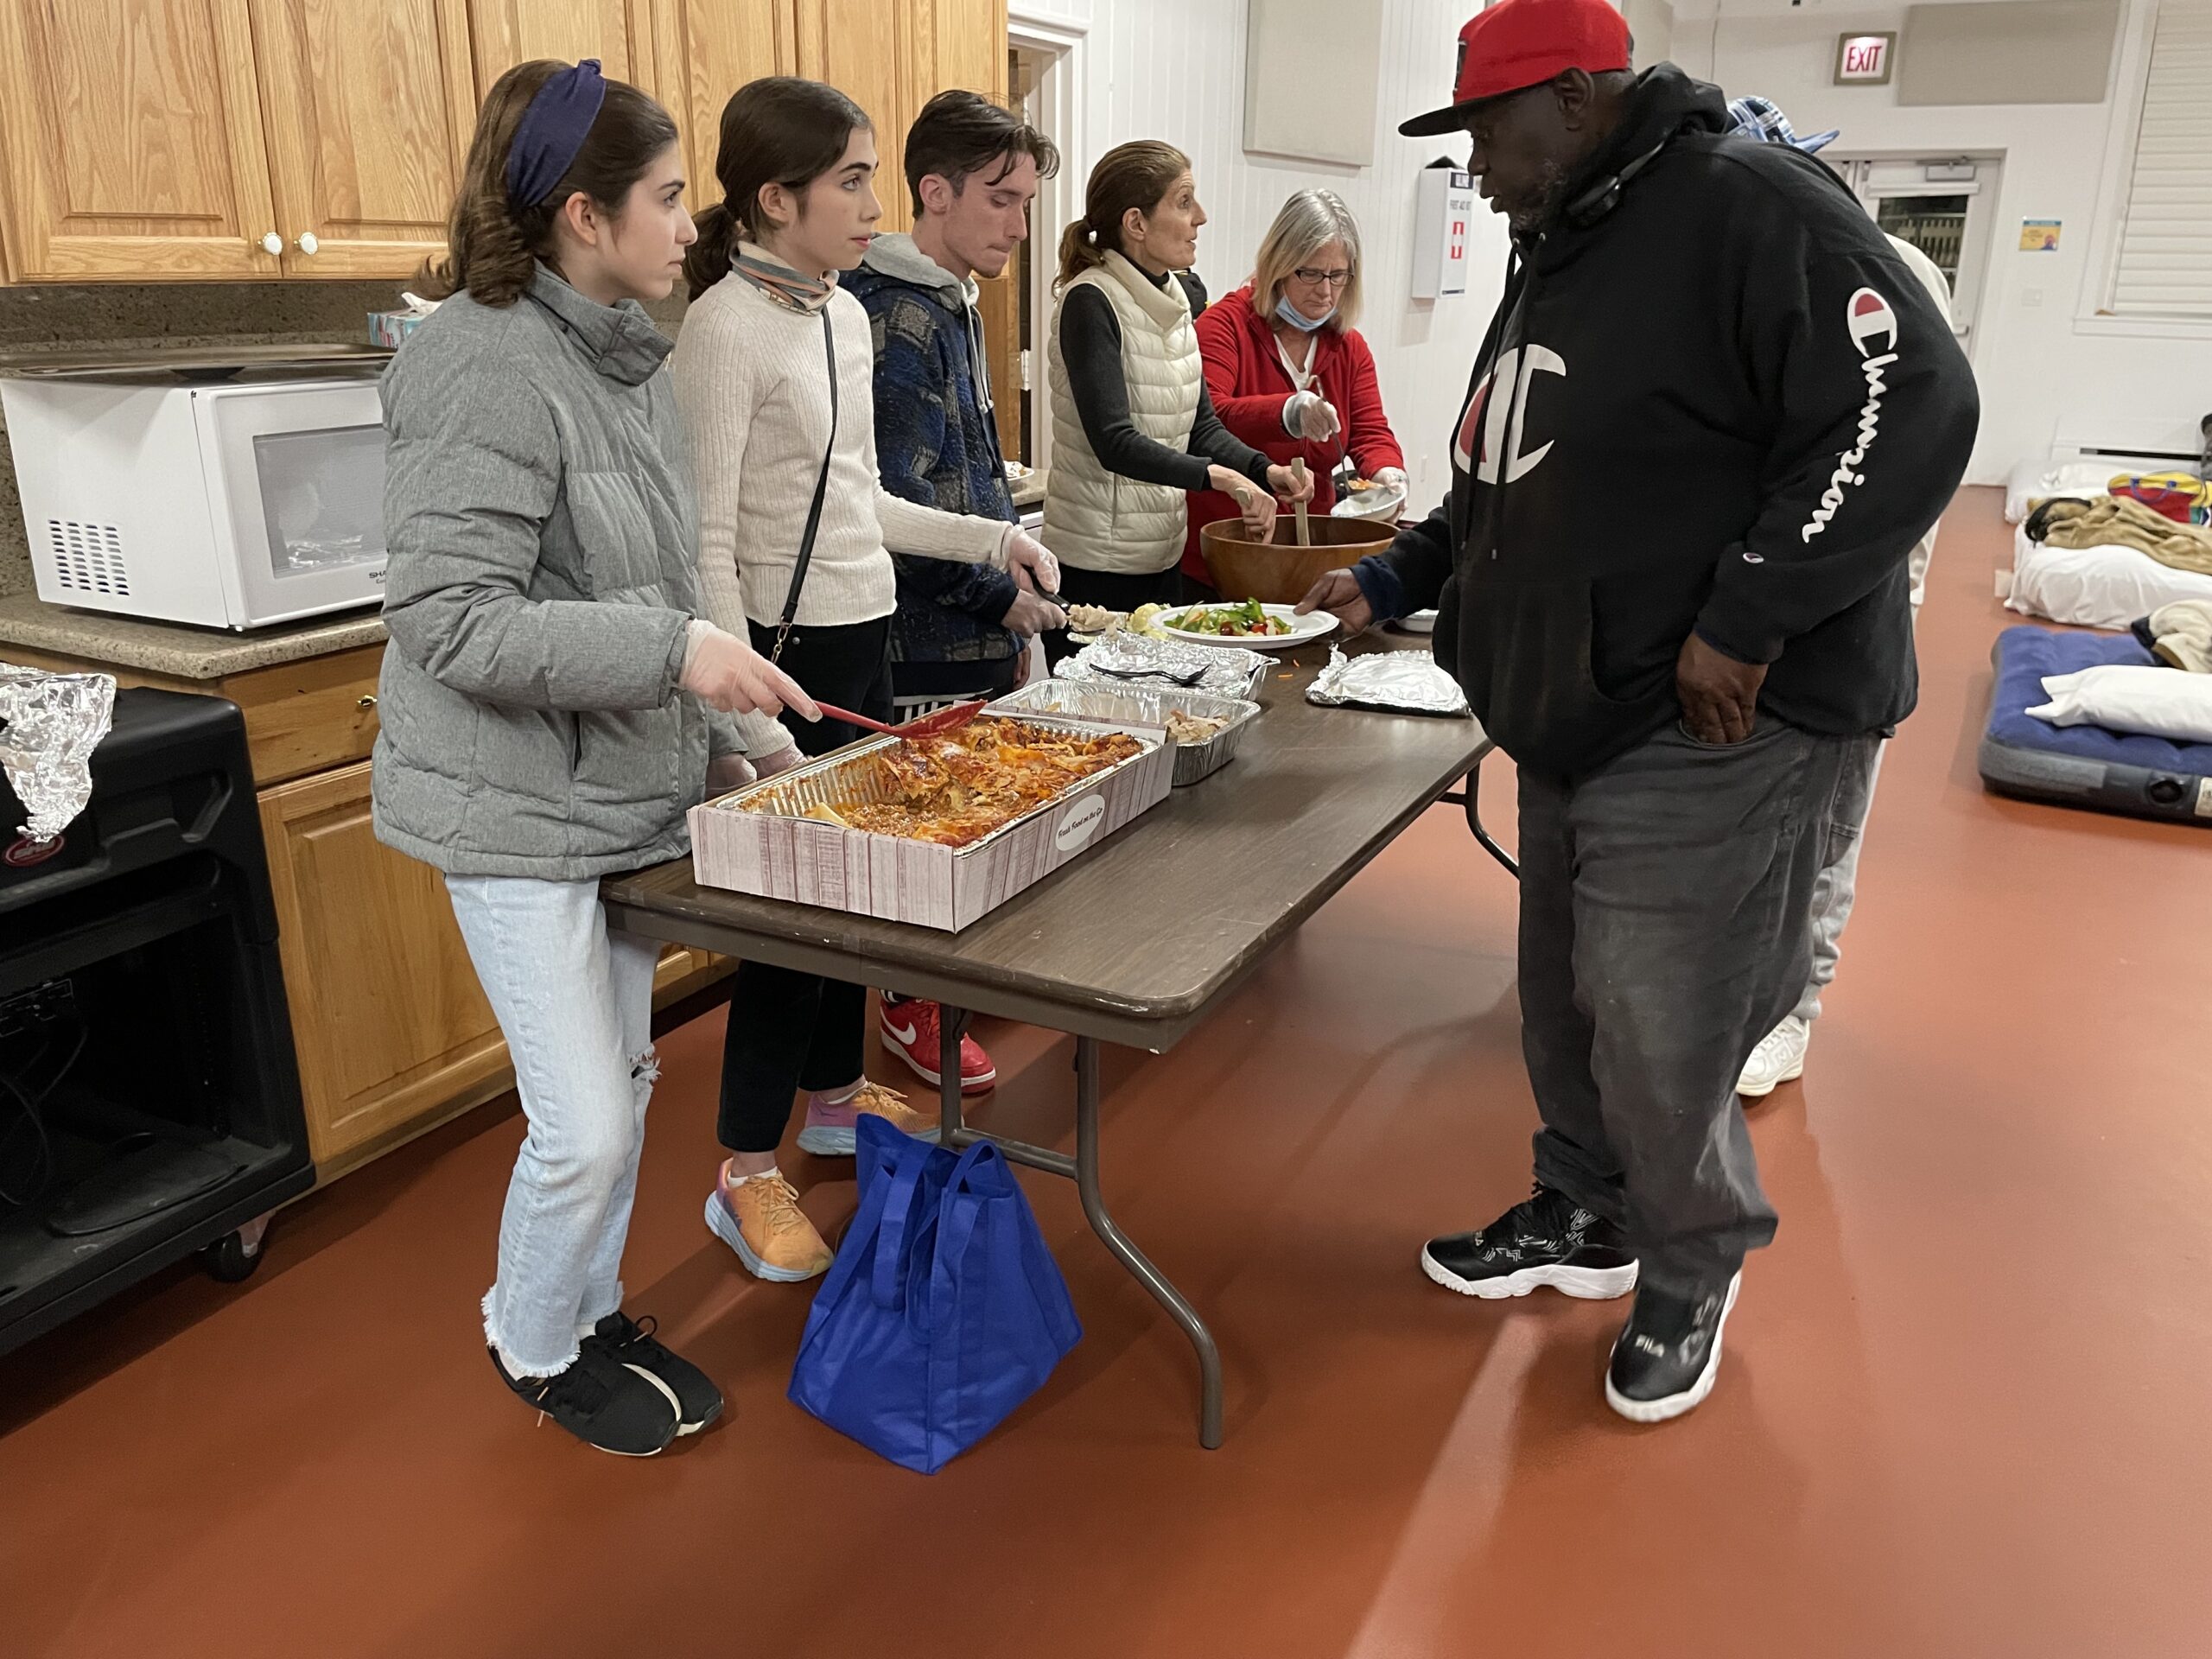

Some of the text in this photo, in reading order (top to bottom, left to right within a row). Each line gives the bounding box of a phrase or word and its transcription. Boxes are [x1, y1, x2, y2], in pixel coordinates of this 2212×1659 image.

[1846, 45, 1883, 72] EXIT
[1071, 817, 1084, 830] Food
[1096, 806, 1103, 817] Go
[1635, 1333, 1665, 1358] FILA
